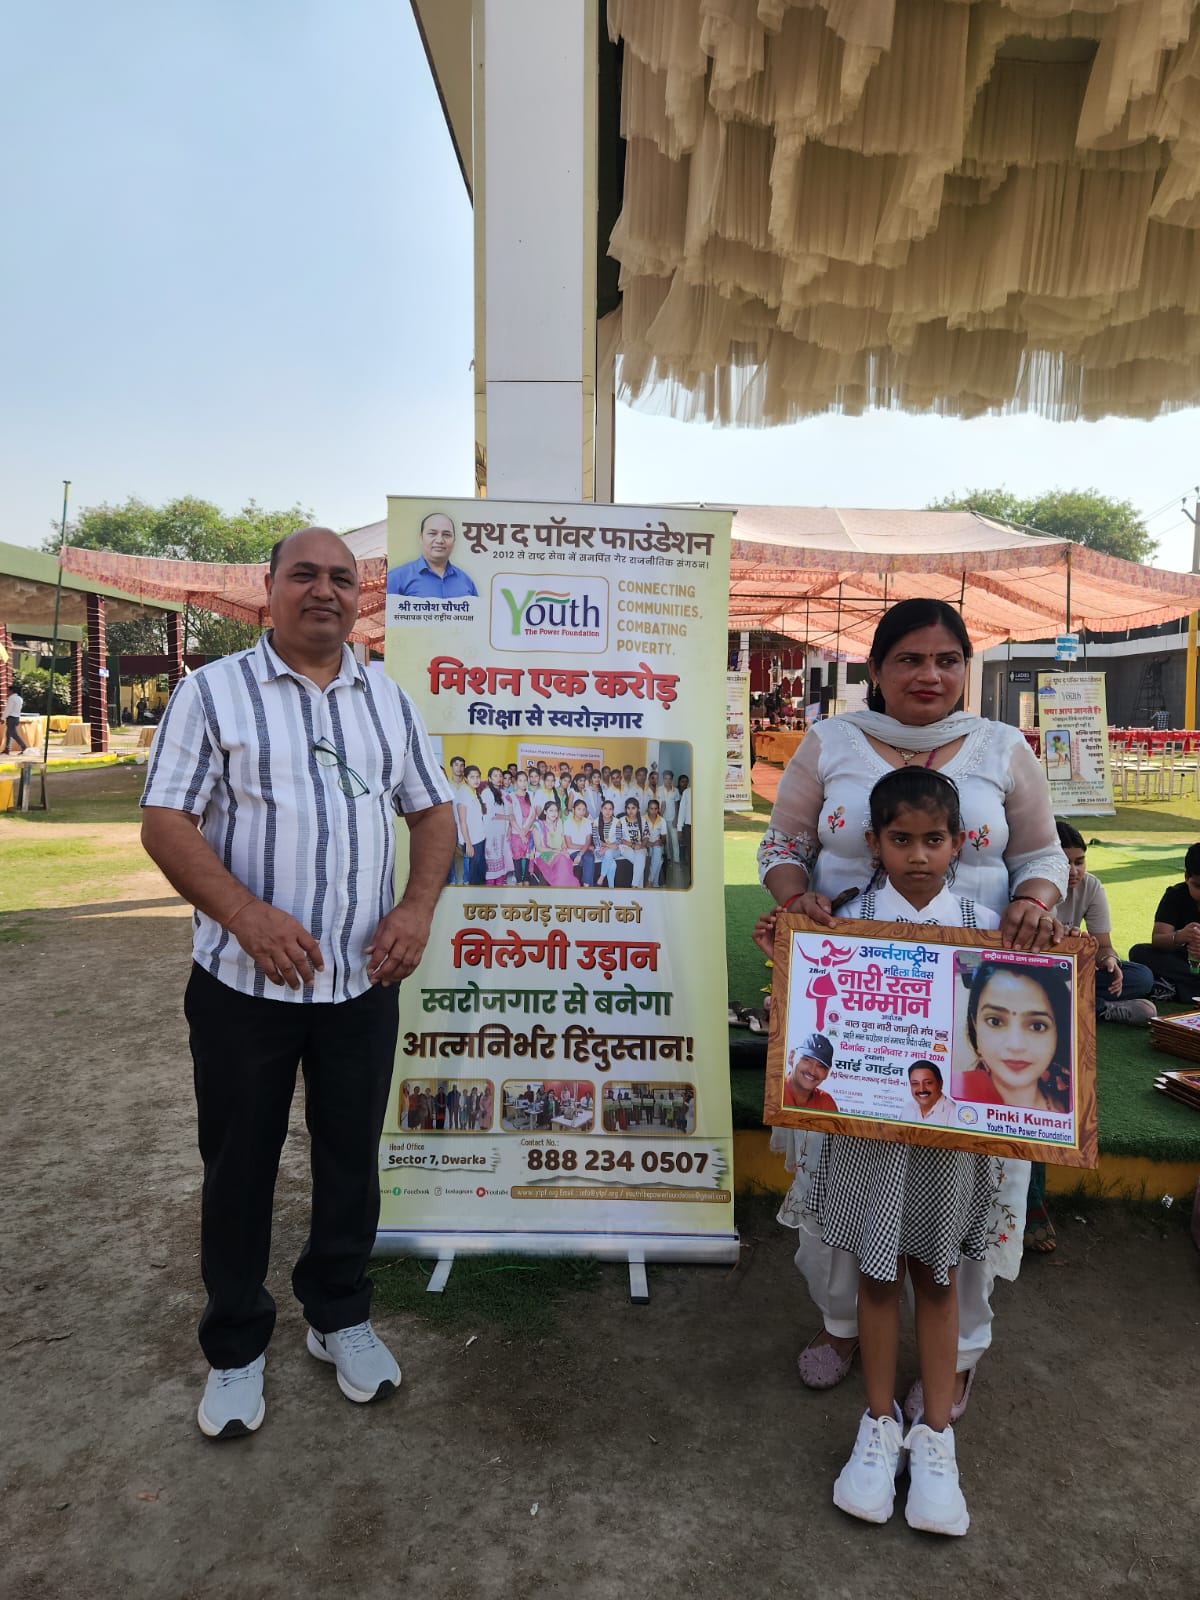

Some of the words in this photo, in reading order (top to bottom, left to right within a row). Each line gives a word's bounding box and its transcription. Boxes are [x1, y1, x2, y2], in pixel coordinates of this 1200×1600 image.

[462, 522, 507, 554] यूथ
[510, 524, 531, 548] द
[533, 516, 596, 549] पॉवर
[599, 521, 715, 556] फाउंडेशन
[493, 551, 514, 559] 2012
[517, 550, 525, 560] से
[549, 551, 565, 561] सेवा
[568, 551, 577, 561] में
[618, 580, 696, 598] CONNECTING
[398, 600, 411, 612] श्री
[413, 600, 439, 612] राजेश
[501, 588, 600, 636] Youth
[525, 628, 537, 636] The
[561, 629, 600, 637] Foundation
[617, 619, 687, 637] COMBATING
[427, 655, 524, 696] मिशन
[528, 668, 589, 699] एक
[592, 662, 680, 710] करोड़
[468, 701, 522, 730] शिक्षा
[525, 704, 546, 726] से
[547, 706, 644, 732] स्वरोज़गार
[463, 903, 498, 921] एक
[501, 899, 551, 927] करोड़
[554, 900, 613, 924] सपनों
[614, 901, 643, 924] को
[450, 927, 571, 970] मिलेगी
[575, 940, 661, 980] उड़ान
[837, 963, 883, 992] नारी
[886, 976, 934, 997] रत्न
[884, 965, 910, 977] महिला
[912, 967, 934, 980] दिवस
[421, 981, 558, 1015] स्वरोजगार
[562, 983, 589, 1016] से
[593, 983, 673, 1016] बनेगा
[841, 990, 931, 1018] सम्मान
[845, 1019, 860, 1029] बाल
[861, 1021, 875, 1032] युवा
[877, 1021, 892, 1032] नारी
[893, 1024, 918, 1037] जागृति
[920, 1026, 933, 1036] मंच
[403, 1023, 557, 1060] आत्मनिर्भर
[561, 1024, 694, 1072] हिंदुस्तान!
[840, 1041, 865, 1052] दिनांक
[873, 1045, 903, 1057] शनिवार
[835, 1058, 862, 1072] सांई
[865, 1063, 905, 1077] गार्डन
[987, 1108, 1019, 1123] Pinki
[1024, 1113, 1072, 1130] Kumari
[987, 1123, 1004, 1133] Youth
[1005, 1125, 1017, 1134] The
[1019, 1127, 1037, 1137] Power
[1038, 1129, 1072, 1142] Foundation
[389, 1143, 405, 1151] Head
[406, 1143, 425, 1151] Office
[520, 1138, 545, 1147] Contact
[388, 1155, 428, 1165] Sector
[430, 1155, 439, 1166] 7,
[441, 1155, 486, 1165] Dwarka
[527, 1149, 578, 1171] 888
[584, 1150, 635, 1172] 234
[641, 1151, 709, 1174] 0507
